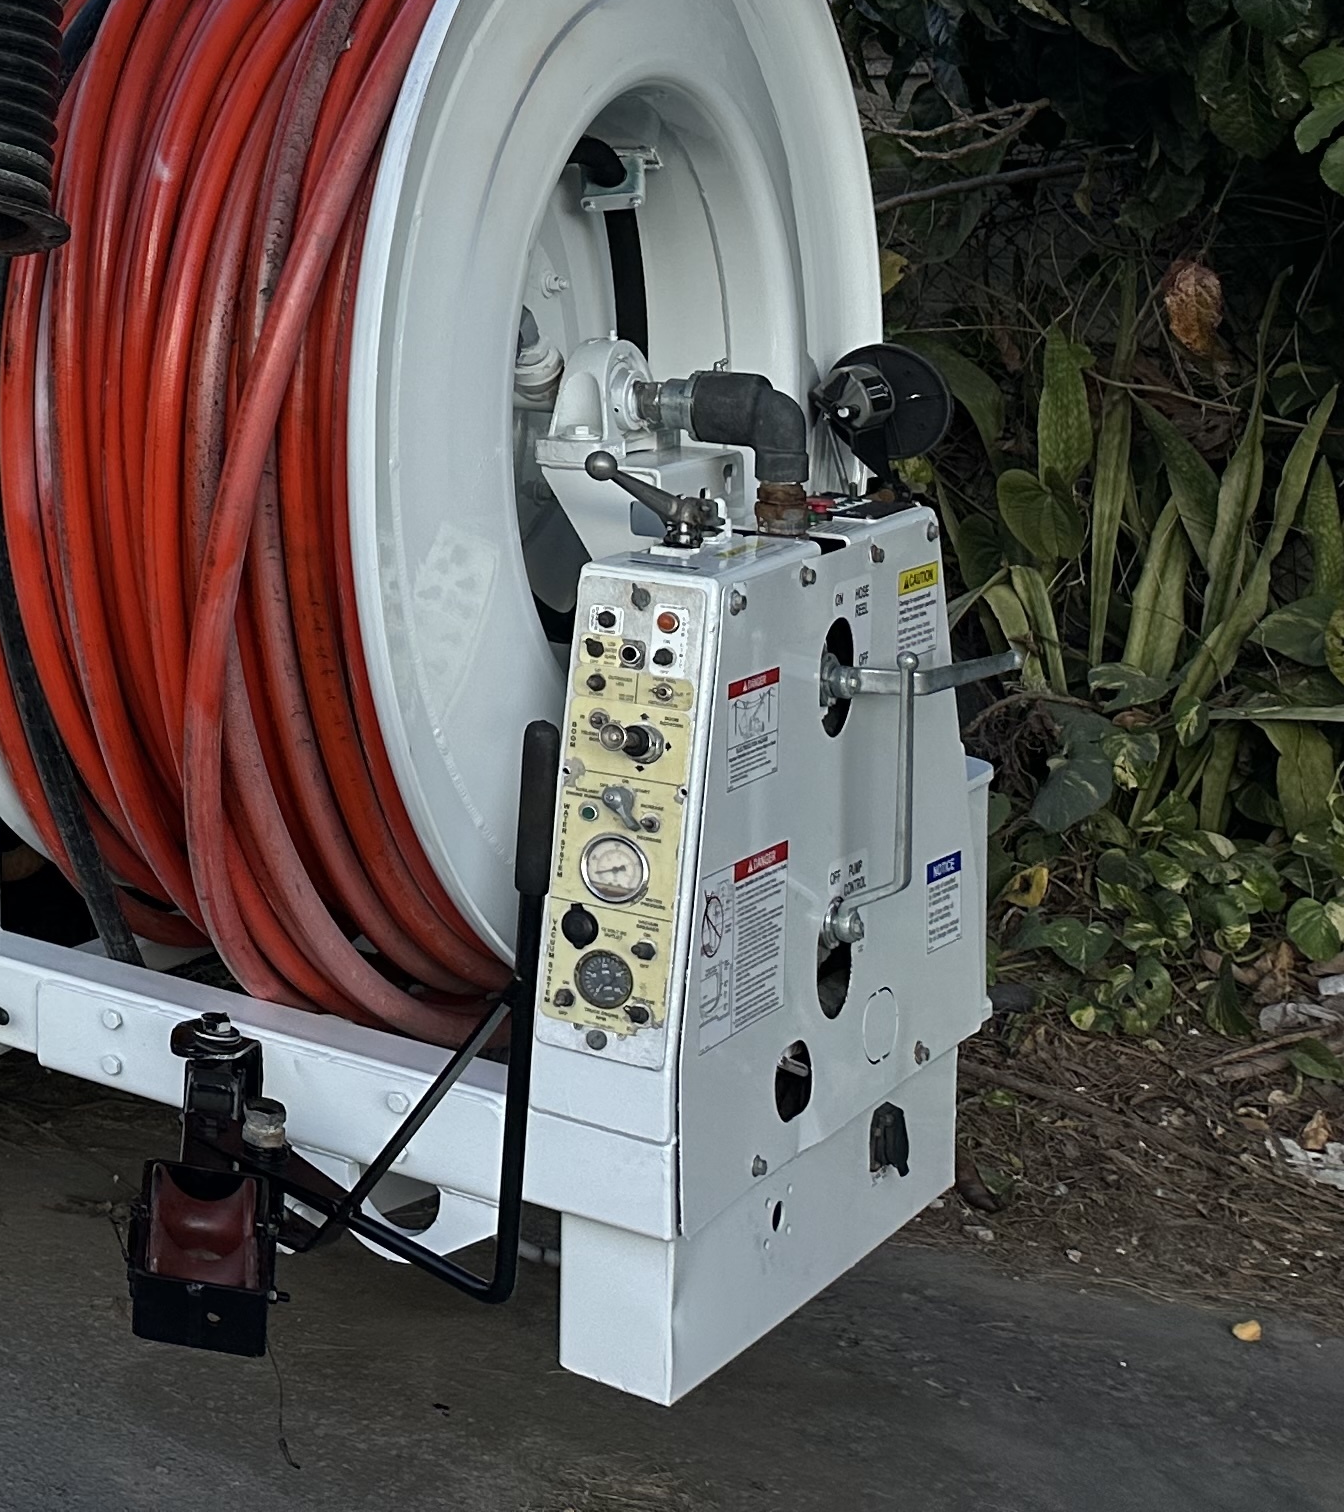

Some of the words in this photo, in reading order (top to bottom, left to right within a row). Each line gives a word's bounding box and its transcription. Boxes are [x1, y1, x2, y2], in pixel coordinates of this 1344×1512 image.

[909, 569, 934, 586] CAUTION
[835, 593, 844, 606] ON
[855, 584, 869, 600] HOSE
[855, 602, 868, 618] REEL
[858, 650, 868, 666] OFF
[569, 721, 578, 748] BOOM
[561, 803, 570, 834] WATER
[557, 840, 566, 878] SYSTEM
[753, 849, 777, 873] DANGER
[933, 857, 955, 878] NOTICE
[830, 869, 841, 885] OFF
[548, 918, 558, 959] VACUUM
[544, 961, 553, 1003] SYSTEM
